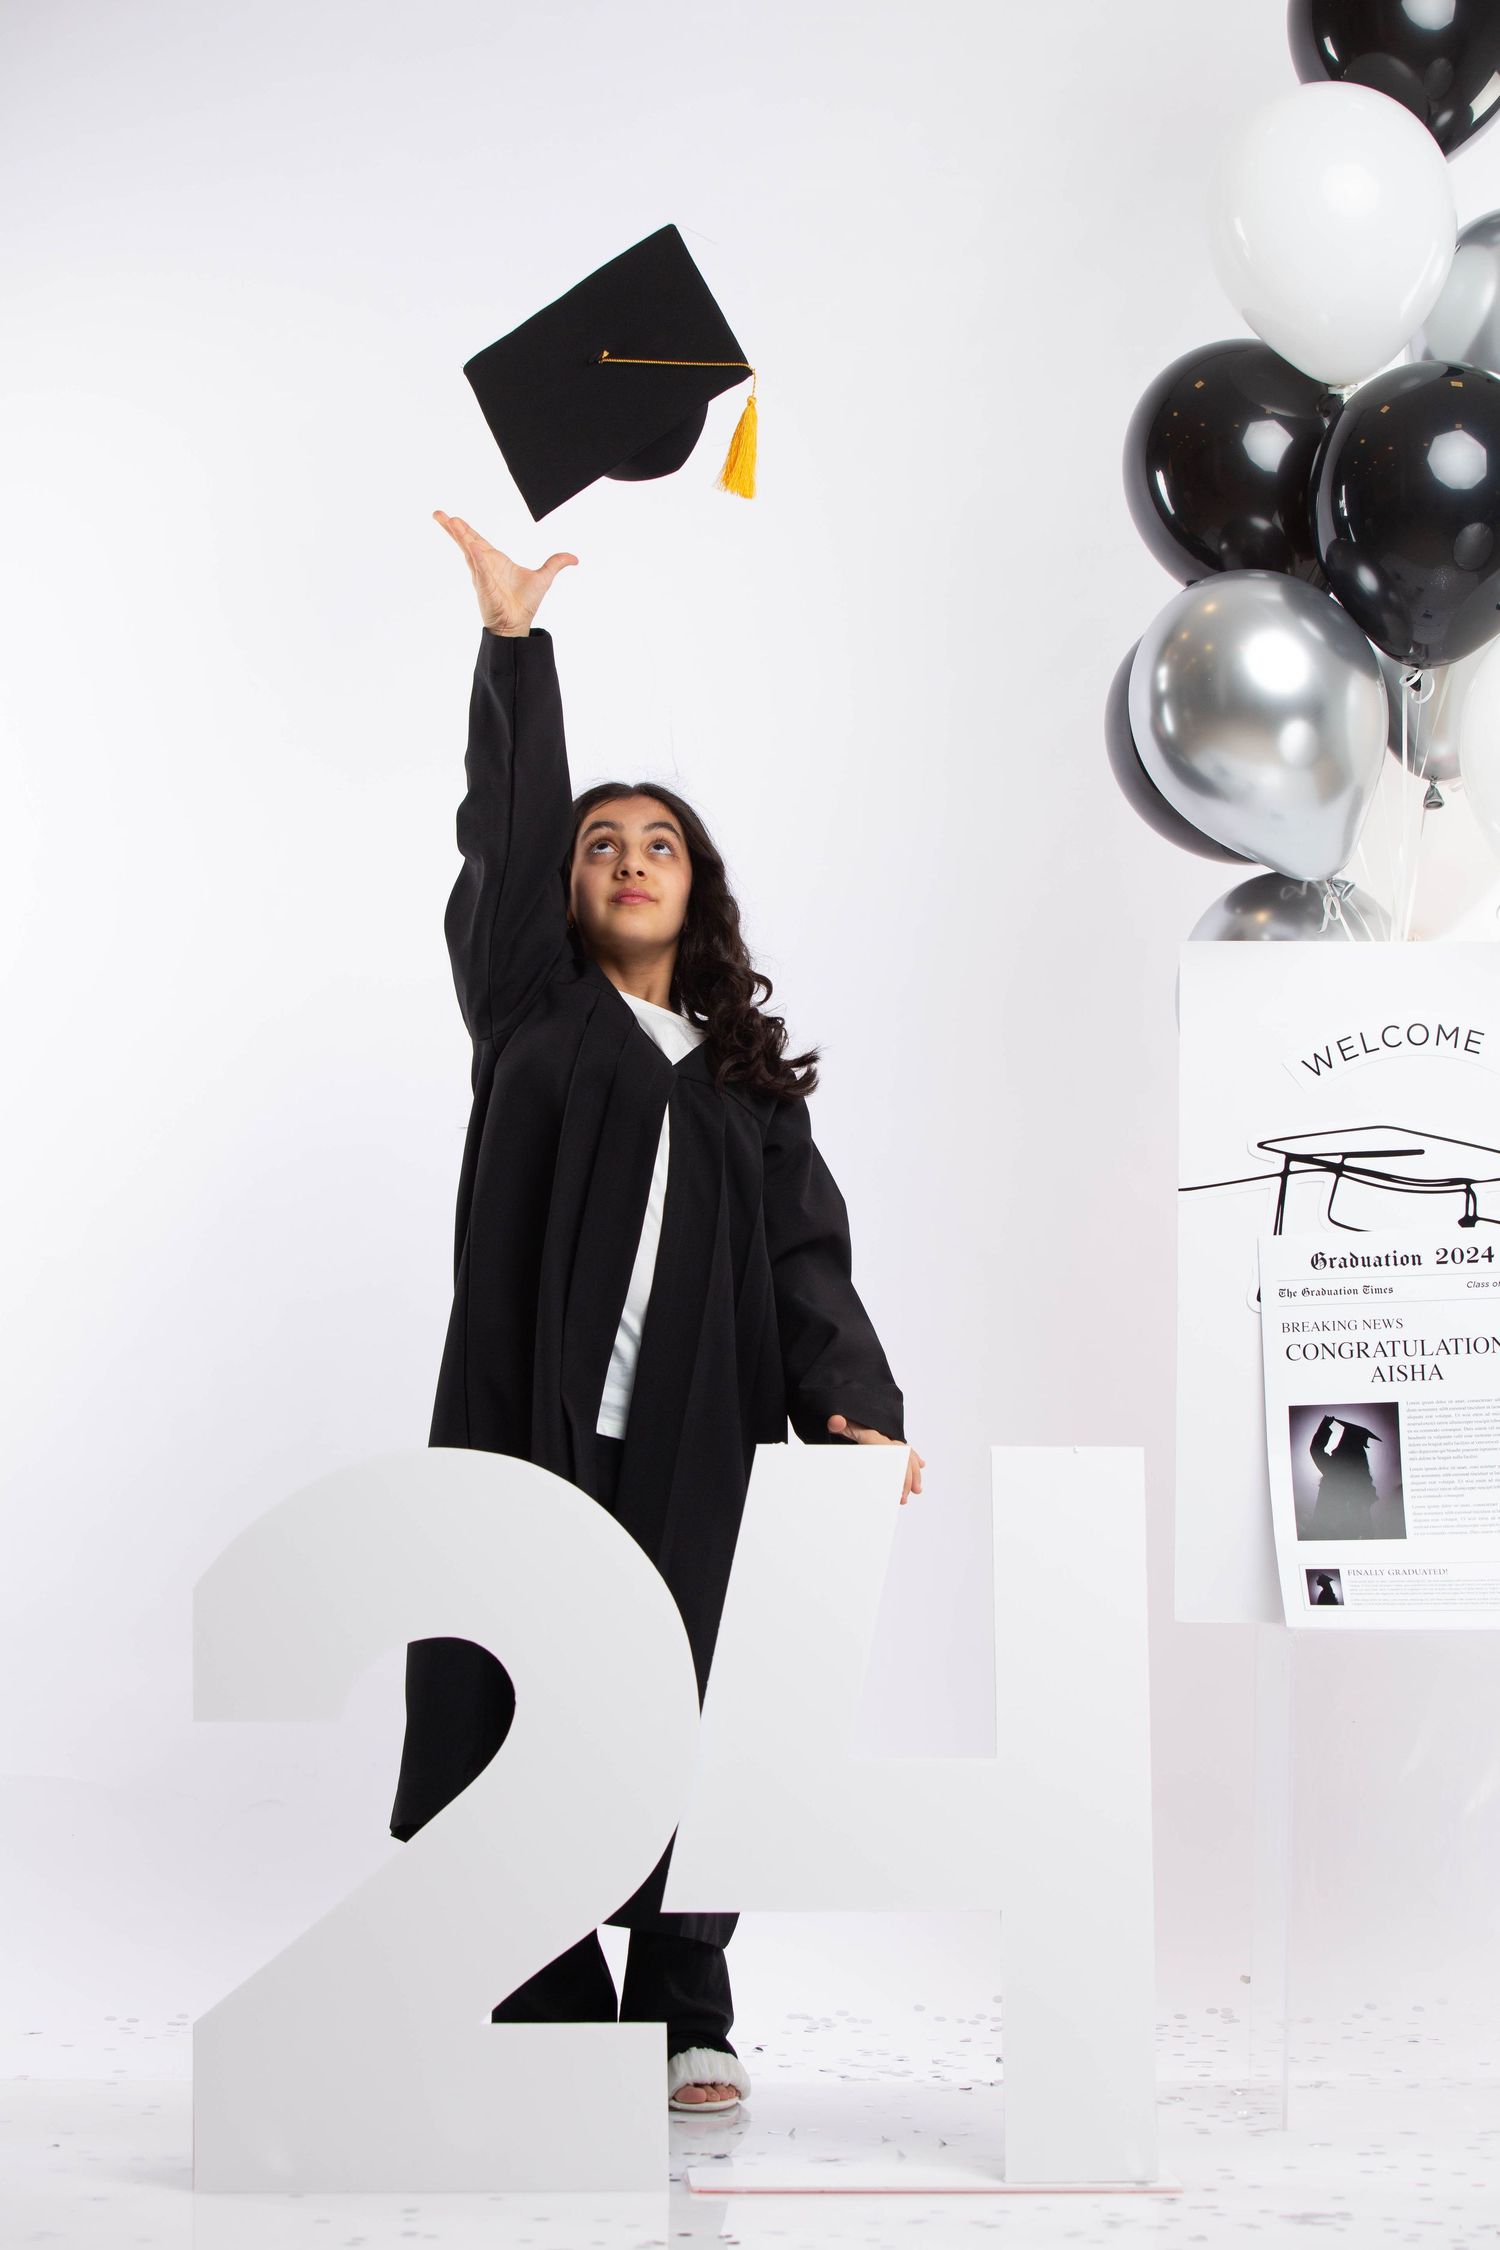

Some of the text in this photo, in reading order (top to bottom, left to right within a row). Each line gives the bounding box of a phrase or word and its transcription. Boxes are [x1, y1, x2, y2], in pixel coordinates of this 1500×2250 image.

[1300, 1022, 1486, 1077] WELCOME
[1310, 1245, 1495, 1271] Graduation 2024
[1278, 1284, 1394, 1299] The Graduation Times
[1466, 1280, 1490, 1289] Class
[1281, 1317, 1404, 1334] BREAKING NEWS
[1370, 1363, 1445, 1384] AISHA
[1347, 1567, 1449, 1577] FINALLY GRADUATED!
